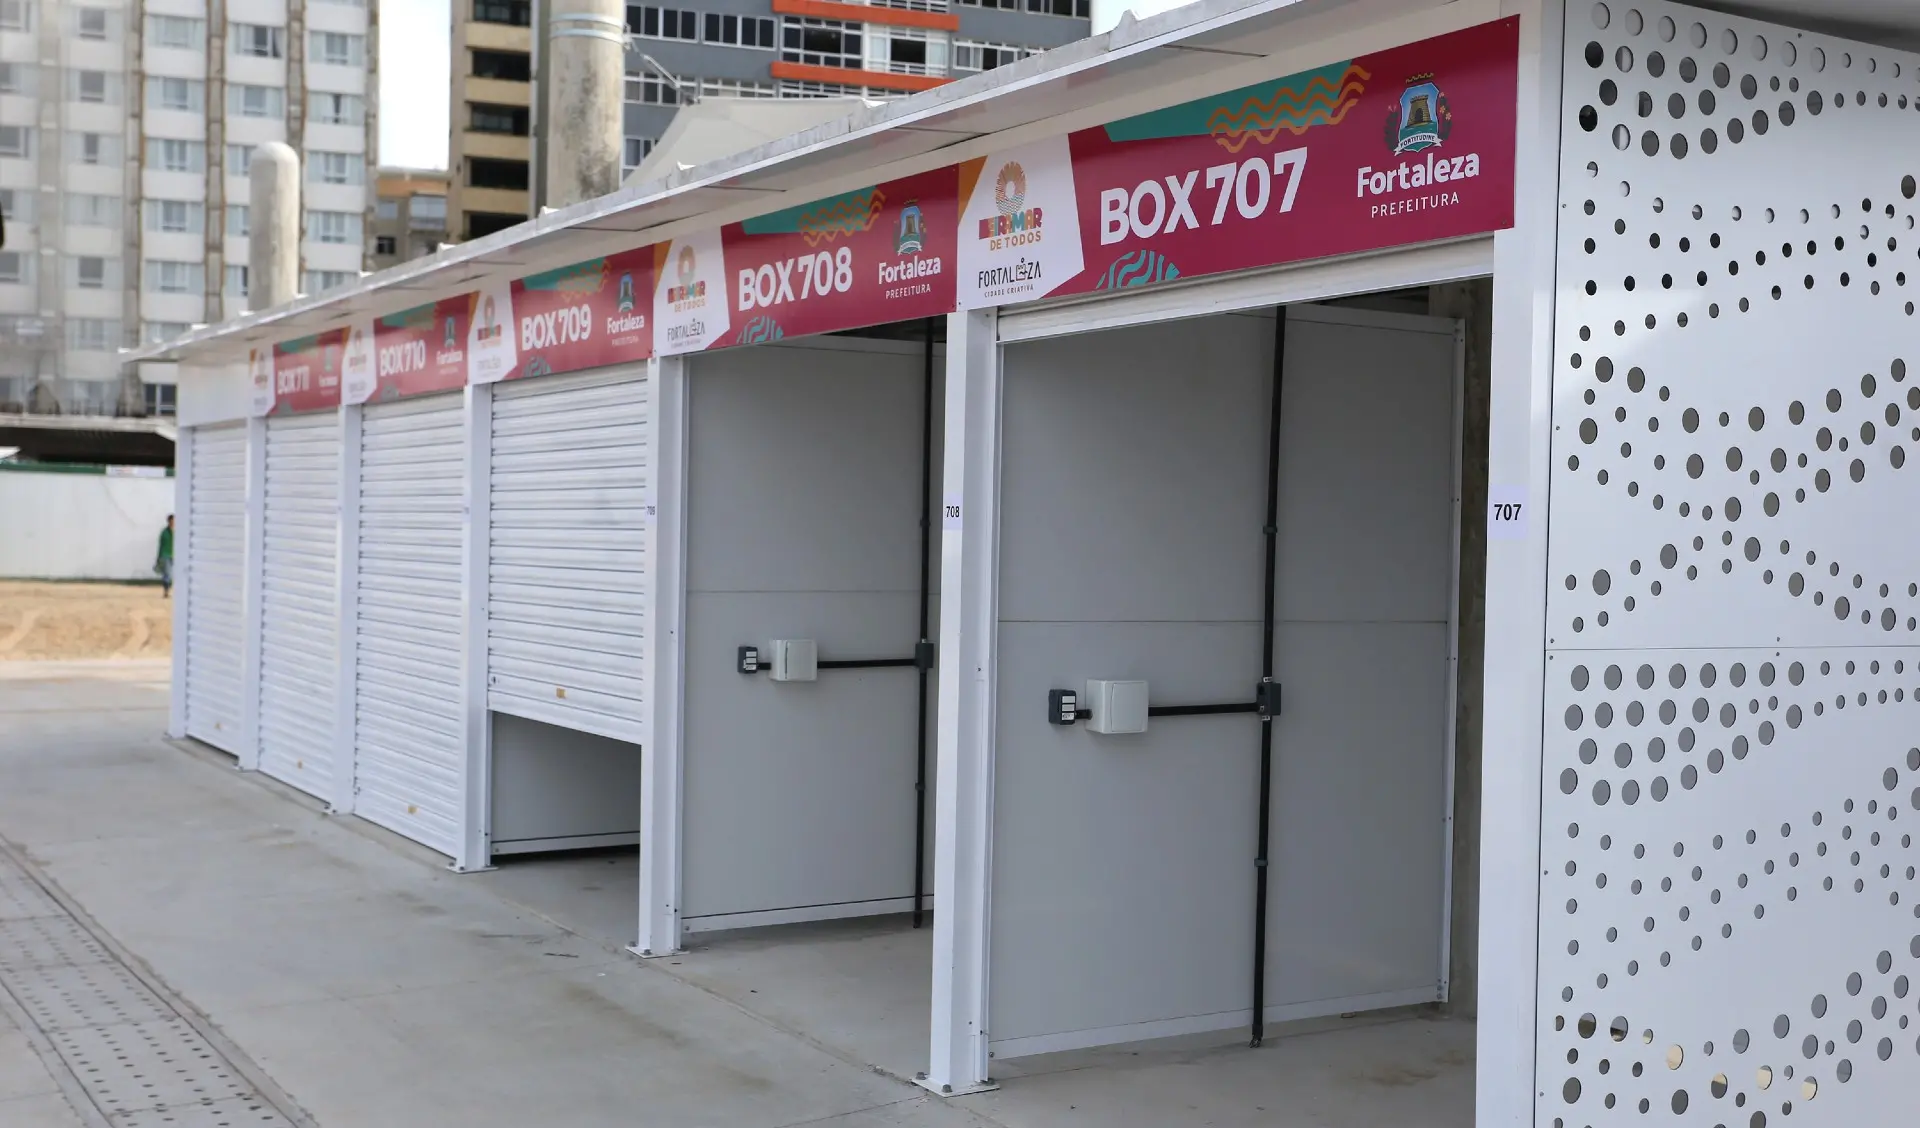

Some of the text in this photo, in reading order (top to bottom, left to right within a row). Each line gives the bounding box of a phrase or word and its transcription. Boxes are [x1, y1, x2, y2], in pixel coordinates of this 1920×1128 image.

[1400, 134, 1435, 148] FORTITUDINE
[1357, 152, 1480, 198] Fortaleza
[1101, 146, 1307, 246] BOX 707
[1371, 191, 1459, 218] PREFEITURA
[990, 230, 1042, 251] DE TODOS
[738, 246, 853, 312] BOX 708
[878, 255, 941, 285] Fortaleza
[885, 283, 931, 299] PREFEITURA
[984, 284, 1034, 298] CIDADE CRIATIVA
[521, 311, 557, 351] BOX
[558, 303, 592, 344] 709
[607, 313, 645, 335] Fortaleza
[380, 344, 404, 377] BOX
[404, 339, 426, 372] 710
[946, 505, 960, 518] 708
[1494, 503, 1522, 521] 707
